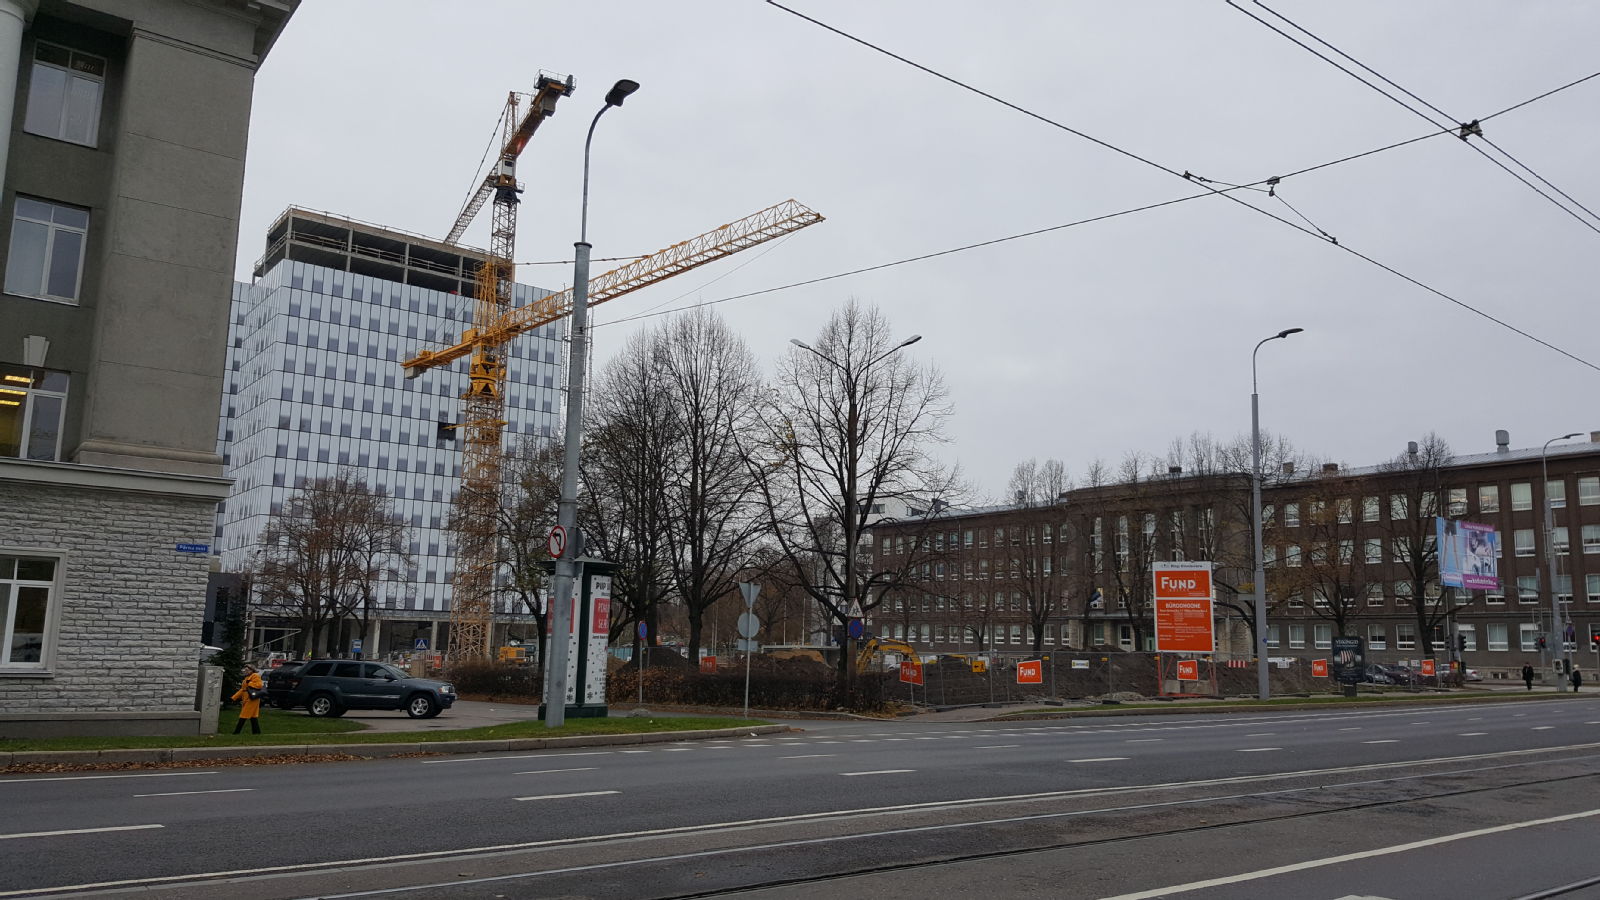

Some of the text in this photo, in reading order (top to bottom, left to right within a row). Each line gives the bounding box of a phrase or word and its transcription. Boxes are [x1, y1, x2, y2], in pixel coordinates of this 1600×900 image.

[1161, 576, 1196, 590] FUND
[1020, 666, 1036, 676] FUND
[1179, 665, 1193, 674] FUND
